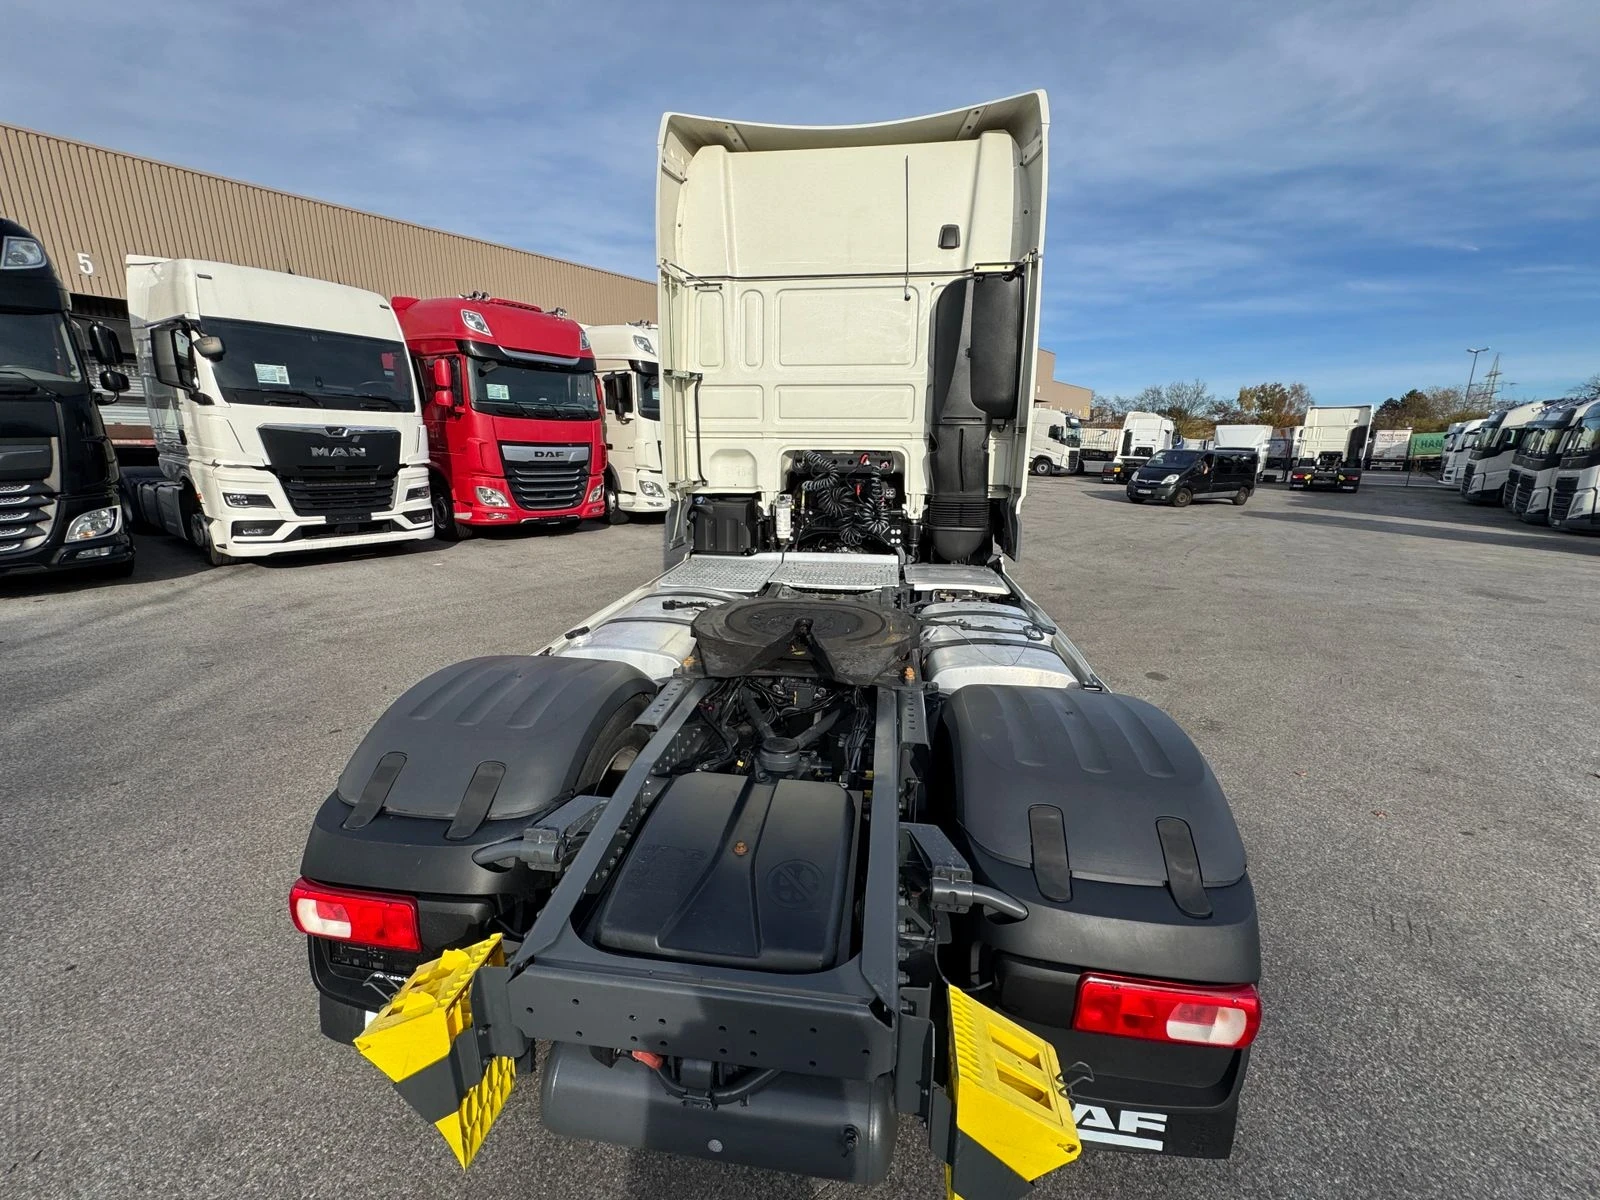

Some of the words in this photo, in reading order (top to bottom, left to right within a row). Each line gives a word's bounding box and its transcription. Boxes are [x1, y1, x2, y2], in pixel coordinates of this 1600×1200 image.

[77, 252, 93, 274] 5
[310, 446, 366, 457] MAN
[1074, 1103, 1168, 1133] AF
